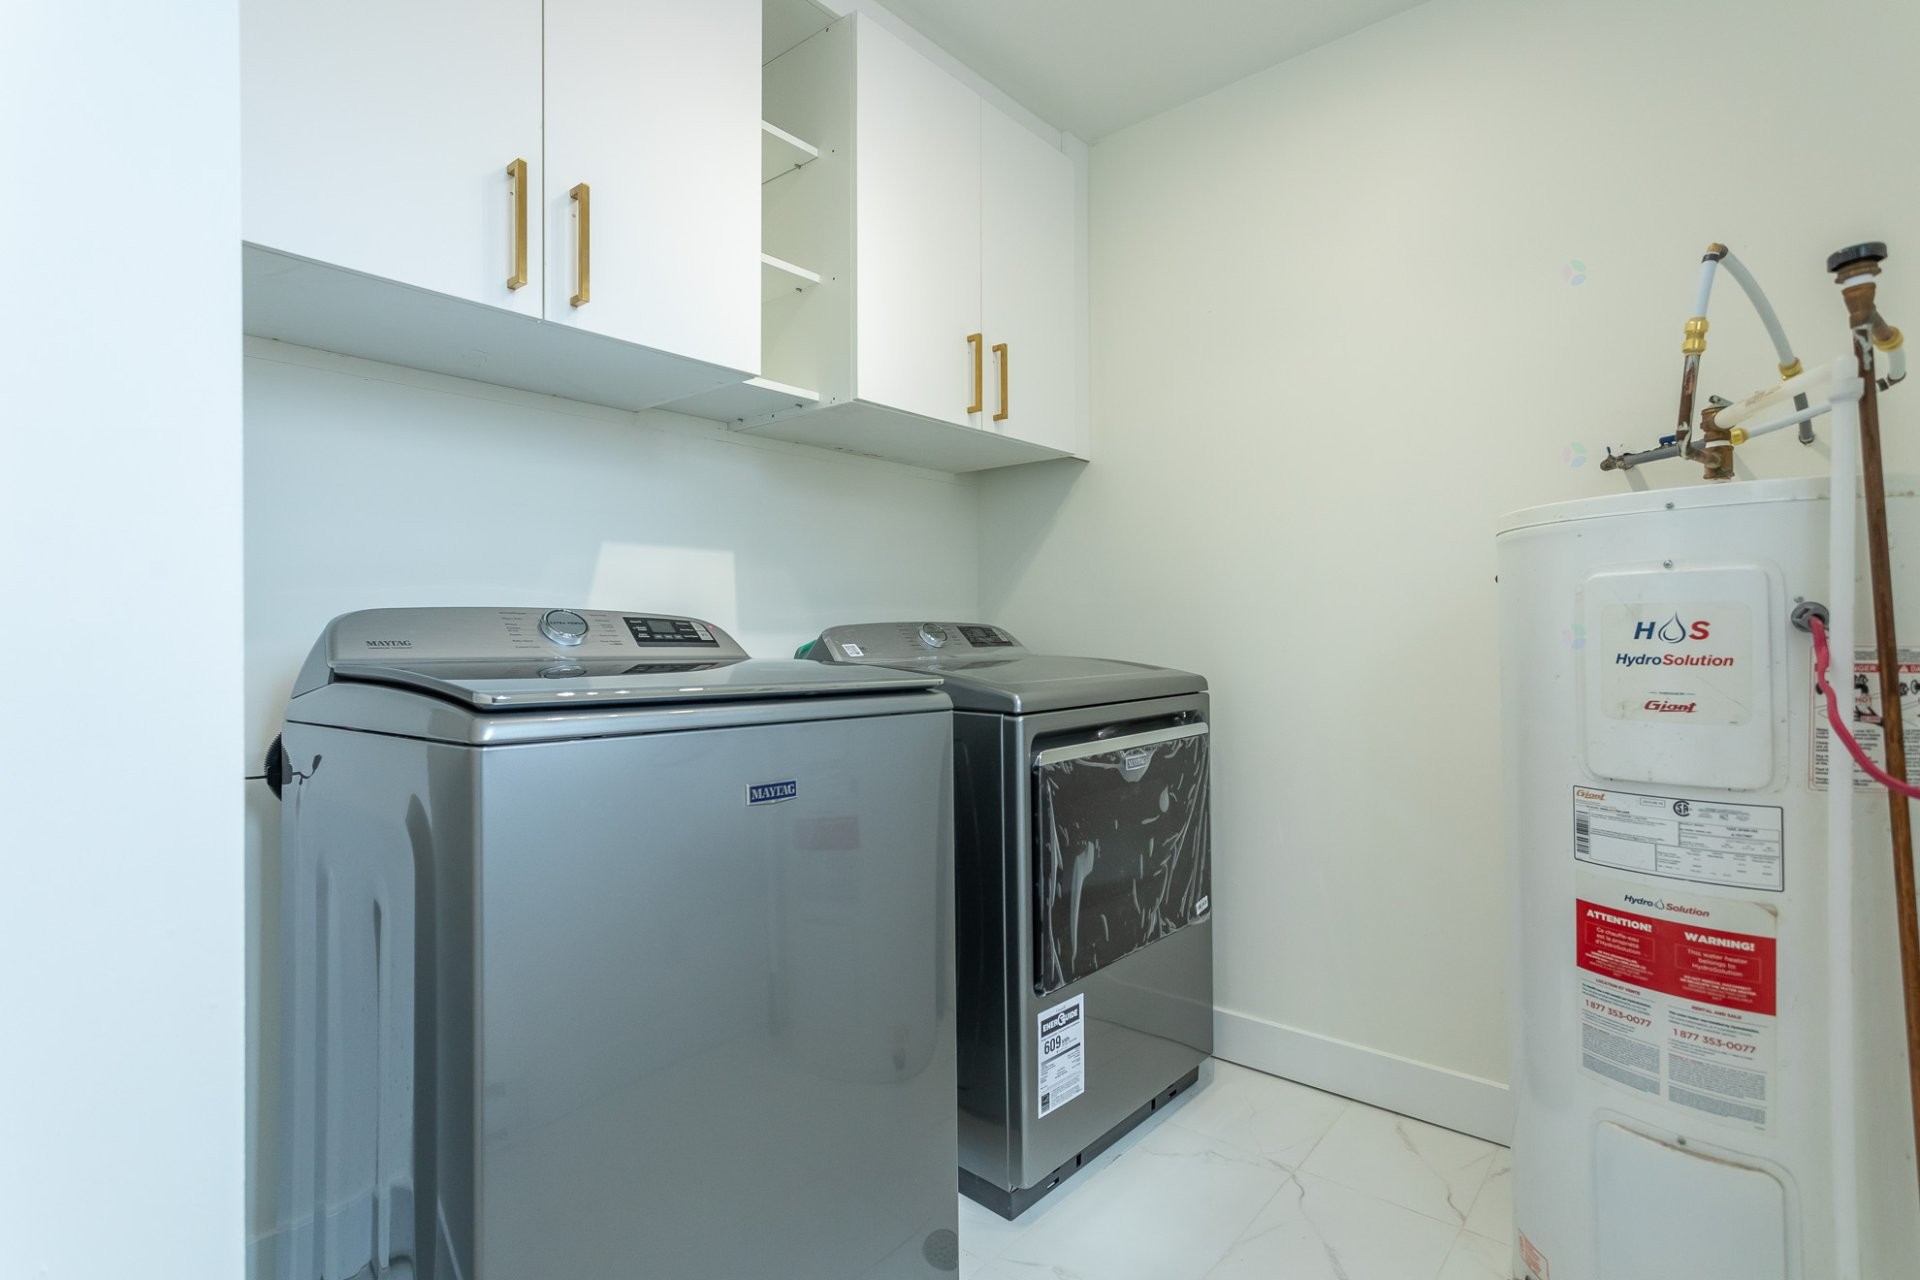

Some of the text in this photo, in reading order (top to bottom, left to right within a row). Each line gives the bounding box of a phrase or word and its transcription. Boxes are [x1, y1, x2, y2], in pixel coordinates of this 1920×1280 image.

[1615, 653, 1735, 668] HydroSolution
[1644, 700, 1698, 713] Giant
[751, 783, 795, 800] MAYTAG
[1576, 789, 1606, 801] Giant
[1666, 903, 1710, 917] Solution
[1586, 909, 1653, 933] ATTENTION!
[1684, 931, 1755, 952] WARNING!
[1687, 948, 1748, 964] This water heater
[1698, 958, 1736, 970] belongs to
[1590, 1001, 1606, 1012] 877
[1607, 1007, 1652, 1027] 353-0077
[1044, 1035, 1061, 1055] 609
[1680, 1030, 1700, 1041] 877
[1702, 1035, 1757, 1053] 353-0077
